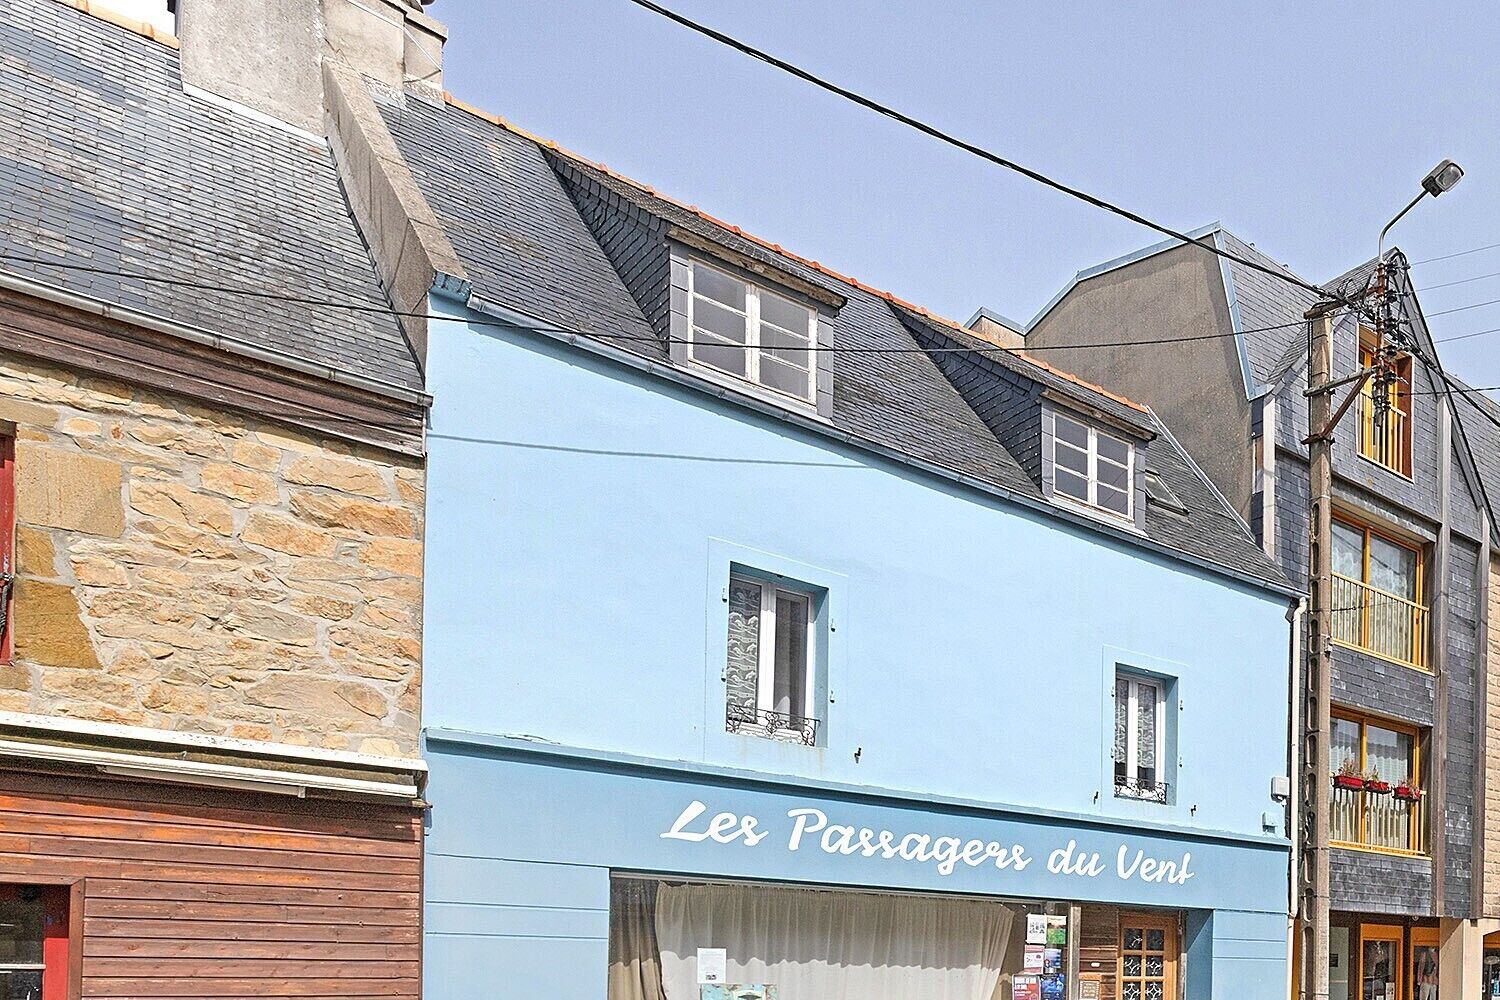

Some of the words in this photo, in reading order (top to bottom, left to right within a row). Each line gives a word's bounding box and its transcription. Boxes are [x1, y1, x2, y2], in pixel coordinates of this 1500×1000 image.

[660, 800, 770, 847] Les
[787, 807, 1033, 876] Passagers
[1046, 839, 1106, 877] du
[1116, 843, 1195, 885] Vent
